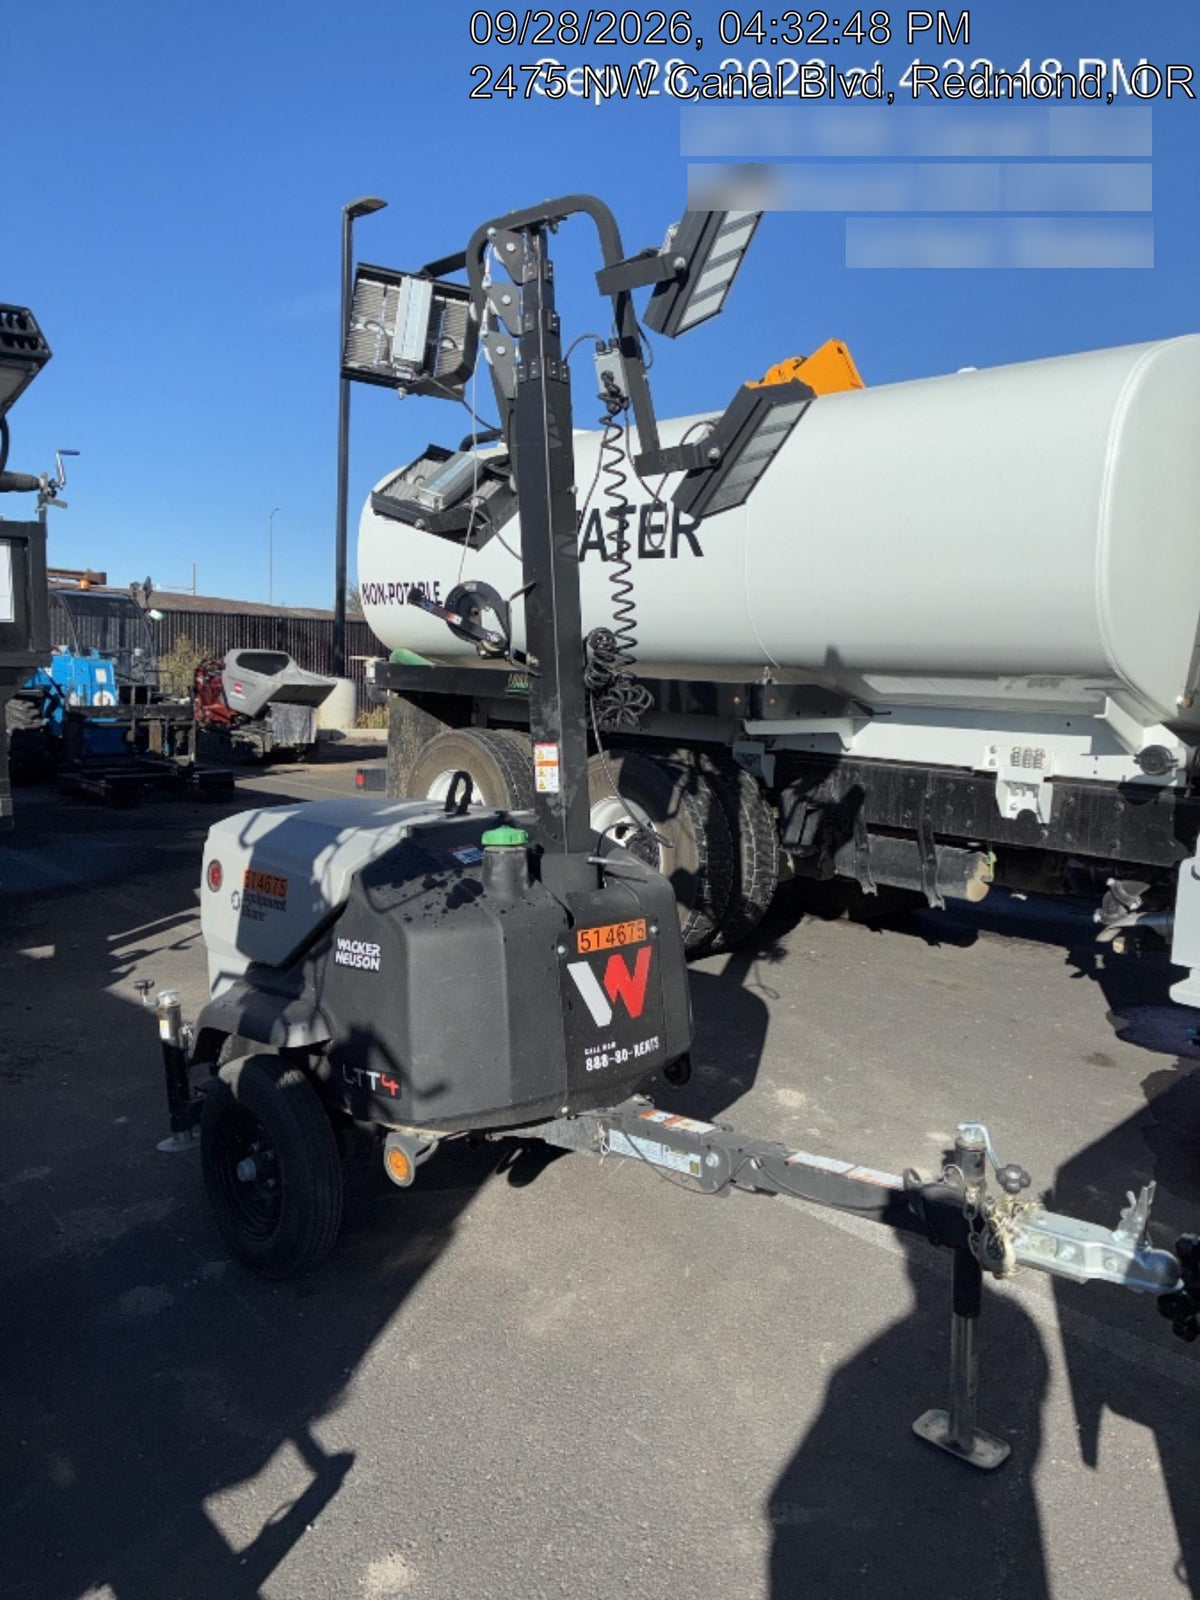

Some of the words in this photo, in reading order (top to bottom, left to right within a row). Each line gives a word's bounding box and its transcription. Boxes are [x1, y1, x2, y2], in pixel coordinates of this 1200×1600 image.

[576, 503, 704, 562] ATER
[337, 938, 381, 957] WACKER
[580, 921, 646, 952] 514675
[335, 951, 381, 971] NEUSON
